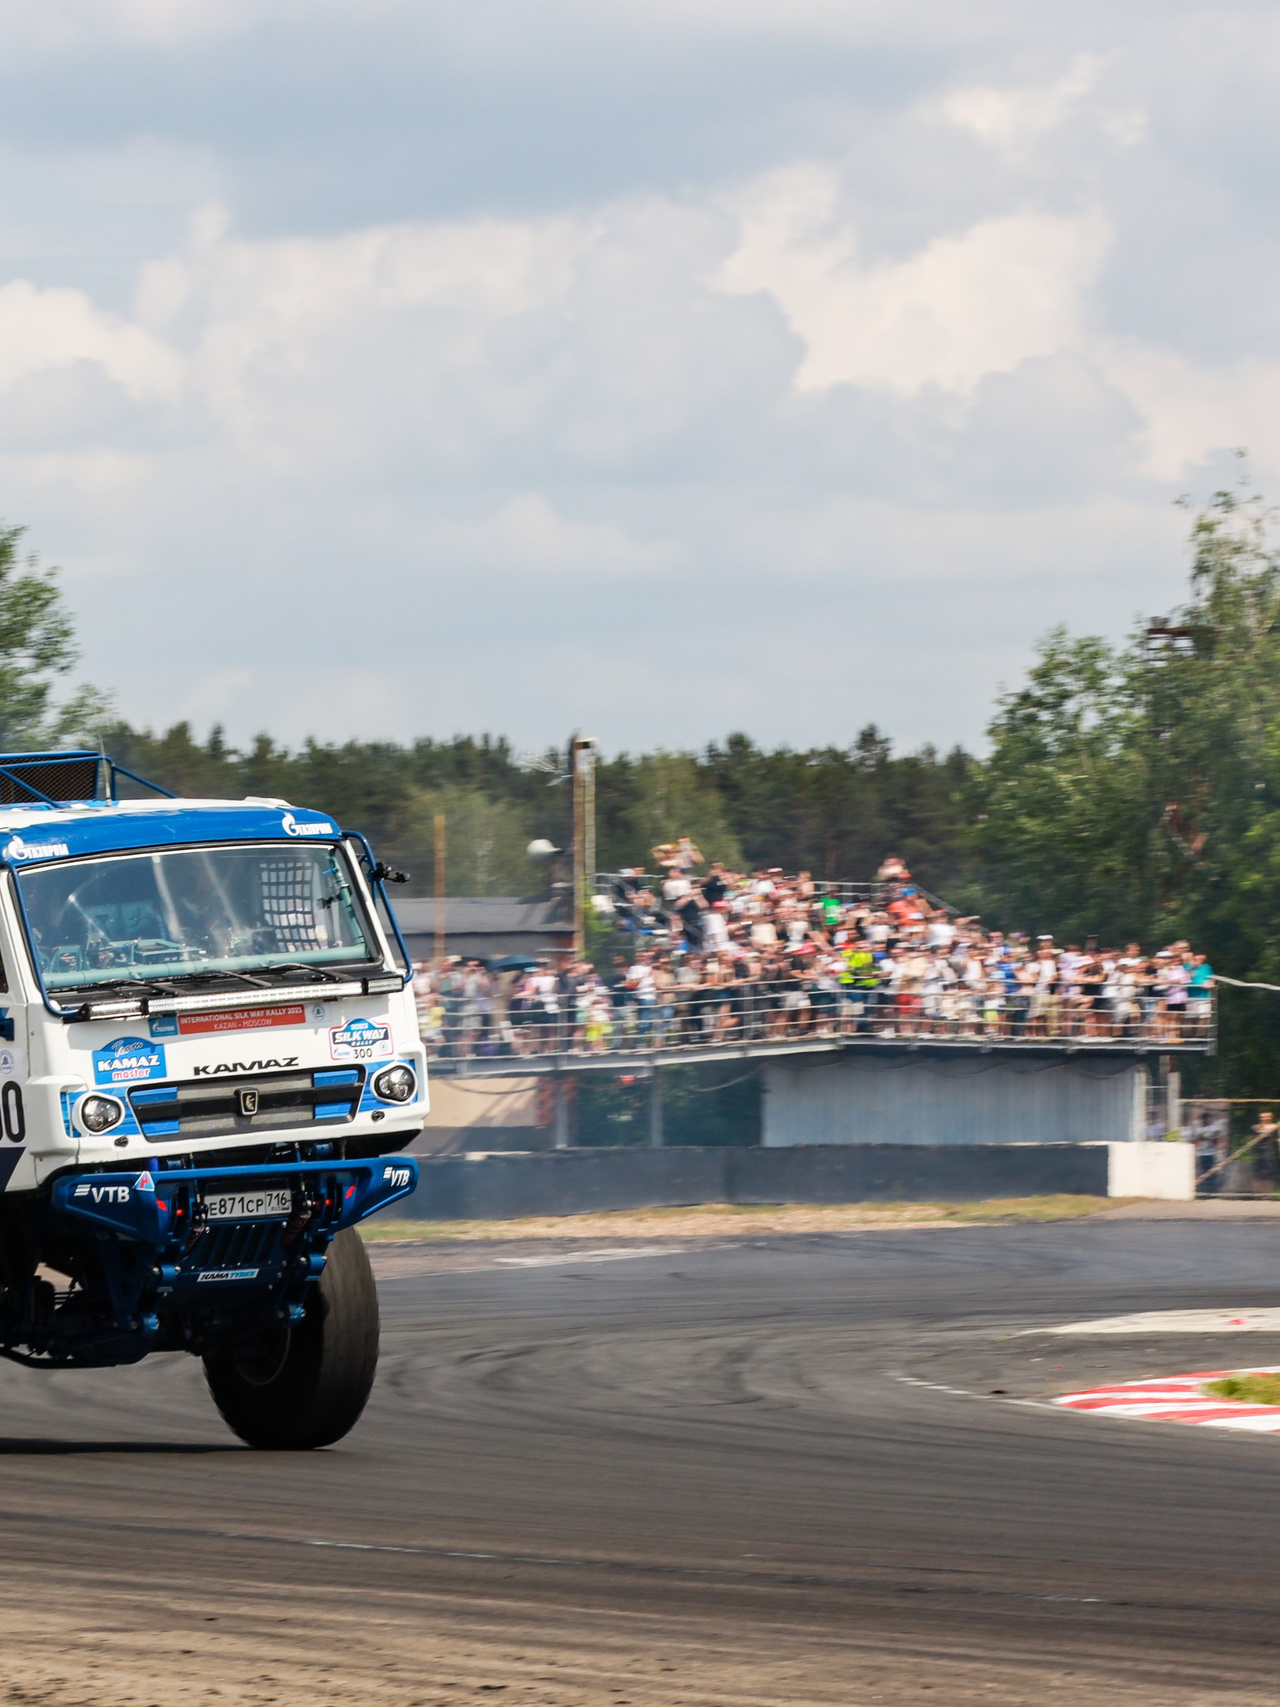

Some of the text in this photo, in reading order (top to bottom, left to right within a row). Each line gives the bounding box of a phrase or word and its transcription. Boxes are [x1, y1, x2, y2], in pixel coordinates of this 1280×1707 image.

[179, 1014, 234, 1024] INTERNATIONAL
[234, 1011, 249, 1020] SILK
[250, 1010, 265, 1018] WAY
[265, 1008, 286, 1017] RALLY
[214, 1021, 237, 1031] KAZAN
[242, 1018, 272, 1028] MOSCOW
[334, 1028, 386, 1044] SILK WAY
[111, 1040, 143, 1057] Team
[353, 1047, 373, 1059] 300
[97, 1054, 160, 1072] KAMAZ
[194, 1057, 299, 1076] KAMAZ
[112, 1068, 150, 1081] master
[390, 1169, 410, 1187] VTB
[91, 1186, 130, 1203] VTB
[266, 1192, 288, 1208] 716
